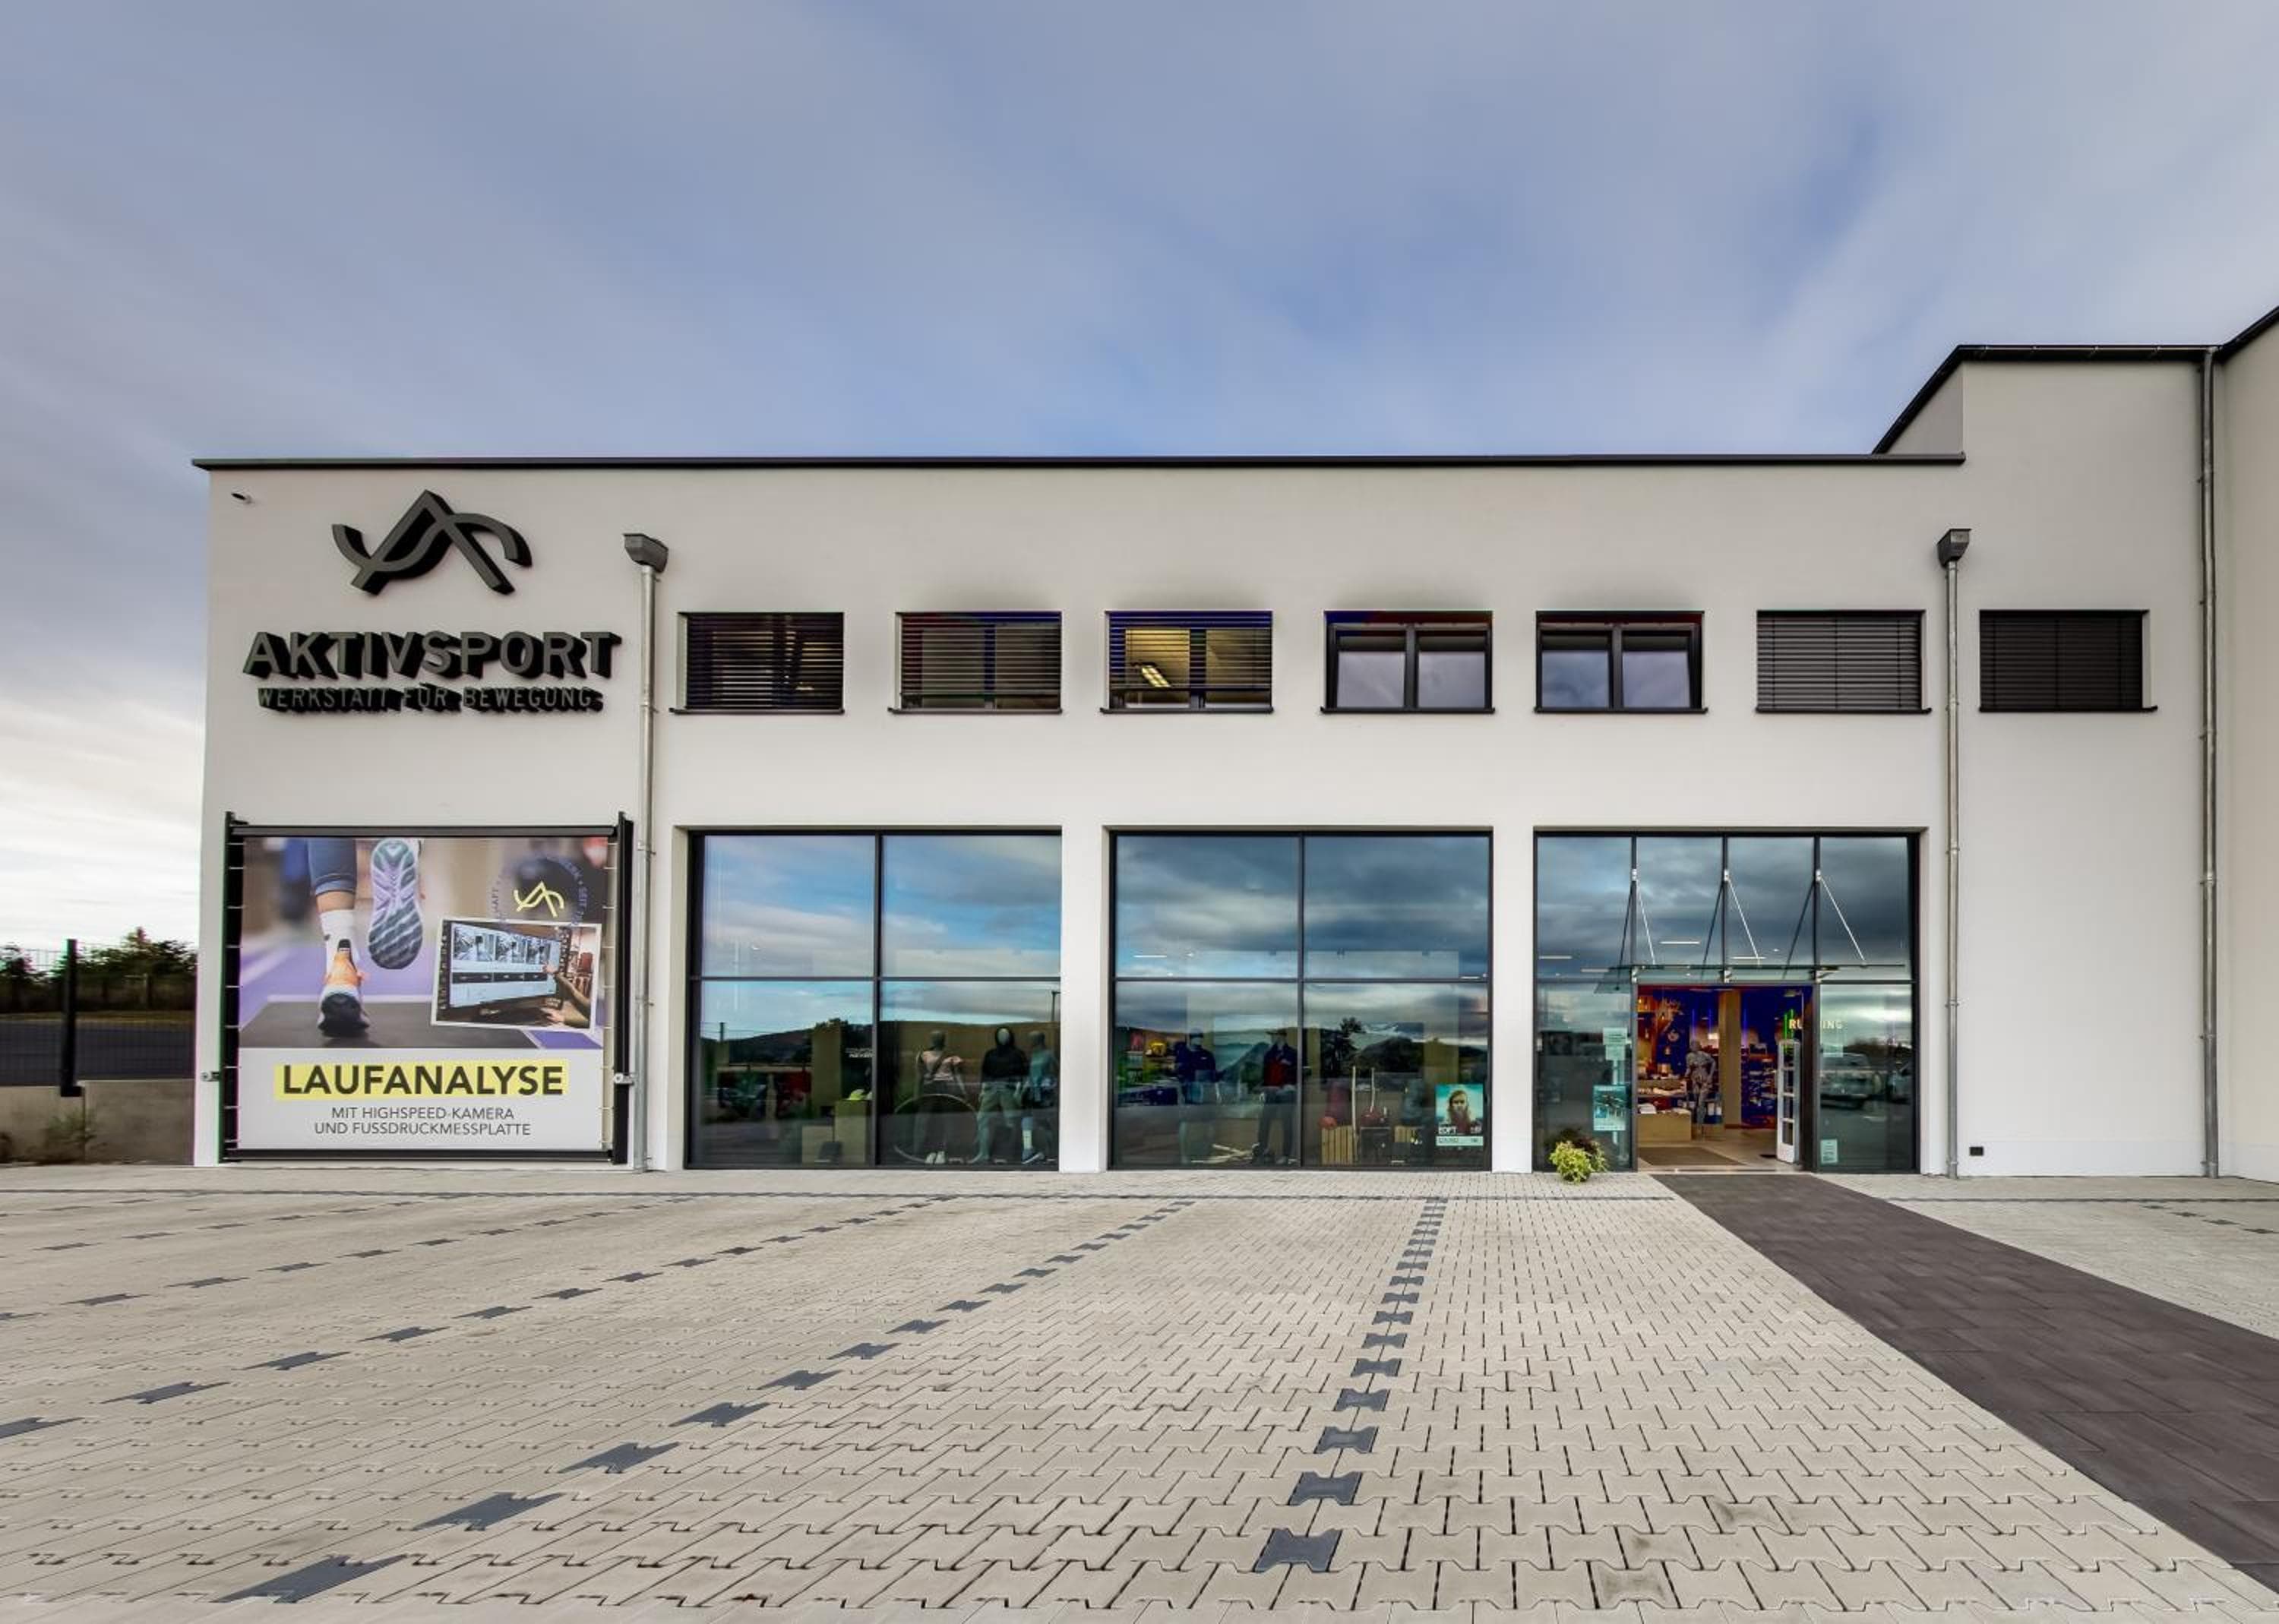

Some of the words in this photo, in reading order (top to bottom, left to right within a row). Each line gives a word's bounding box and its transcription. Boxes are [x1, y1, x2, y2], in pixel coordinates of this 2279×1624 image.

[243, 631, 617, 678] AKTIVSPORT
[258, 687, 393, 710] WERKSTATT
[463, 686, 599, 710] BEWEGUNG
[1789, 1019, 1843, 1029] RUING
[283, 1065, 564, 1096] LAUFANALYSE
[331, 1107, 357, 1119] MIT
[315, 1122, 348, 1134] UND
[352, 1122, 531, 1136] FUSSDRUCKMESSPLATTE
